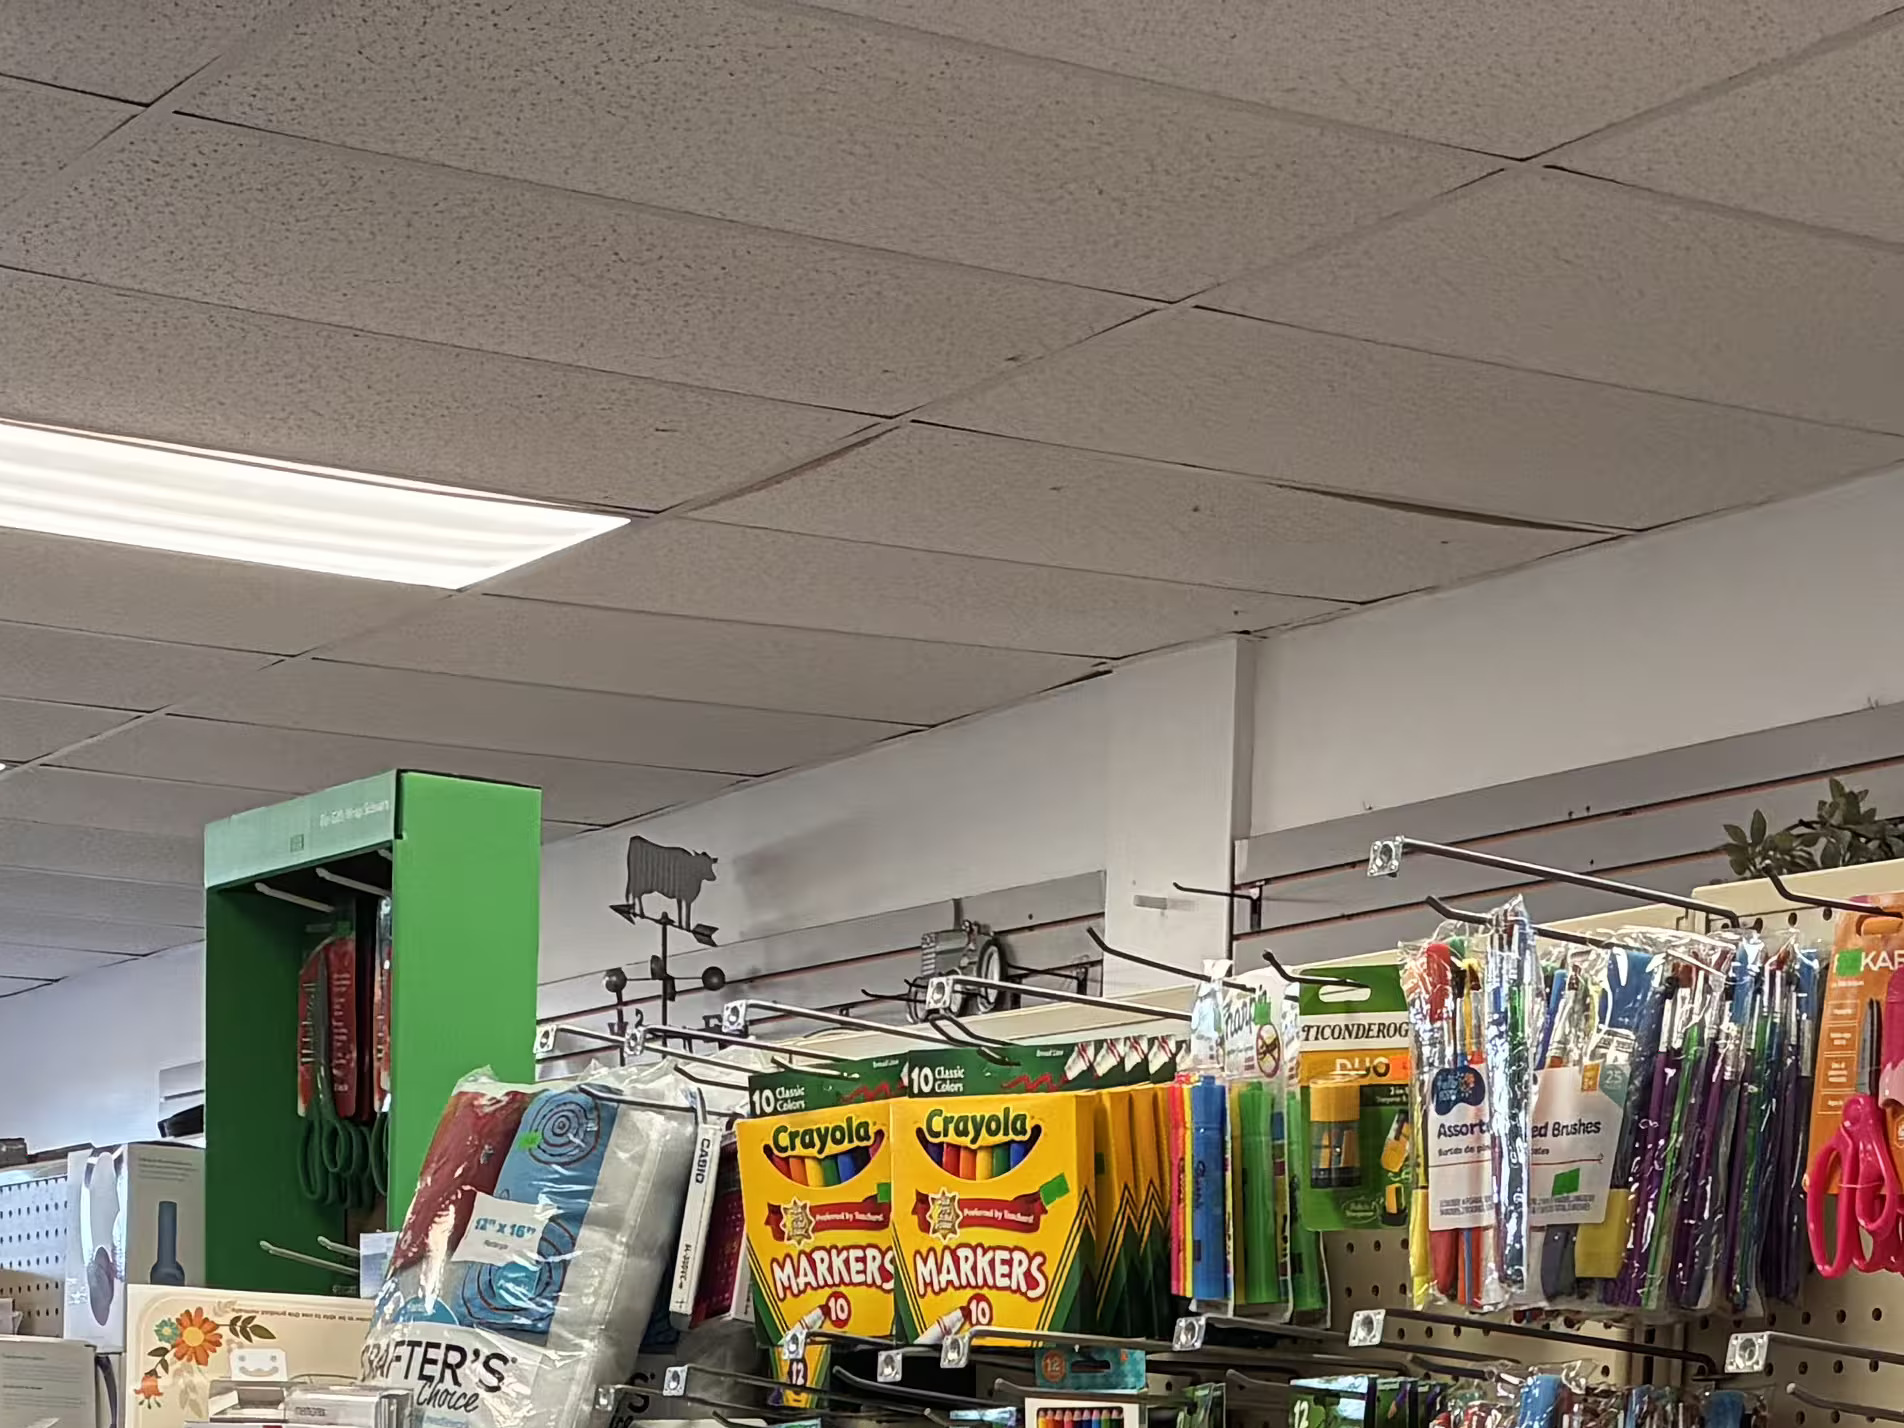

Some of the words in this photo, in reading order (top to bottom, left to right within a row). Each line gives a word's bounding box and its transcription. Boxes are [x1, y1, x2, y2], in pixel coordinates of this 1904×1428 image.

[1302, 1020, 1410, 1043] TICONDEROG
[910, 1066, 934, 1094] 10
[934, 1065, 965, 1080] Classic
[1335, 1056, 1392, 1078] DUO
[752, 1089, 776, 1115] 10
[776, 1085, 805, 1099] Classic
[934, 1080, 964, 1093] Colors
[776, 1100, 805, 1113] Colors
[772, 1115, 872, 1155] Crayola
[925, 1106, 1029, 1148] Crayola
[1551, 1119, 1602, 1138] Brushes
[695, 1137, 713, 1184] CASIO
[772, 1246, 895, 1300] MARKERS
[915, 1246, 1047, 1301] MARKERS
[827, 1297, 848, 1323] 10
[969, 1299, 991, 1325] 10
[361, 1339, 508, 1393] CRAFTER'S
[416, 1381, 480, 1414] Choice
